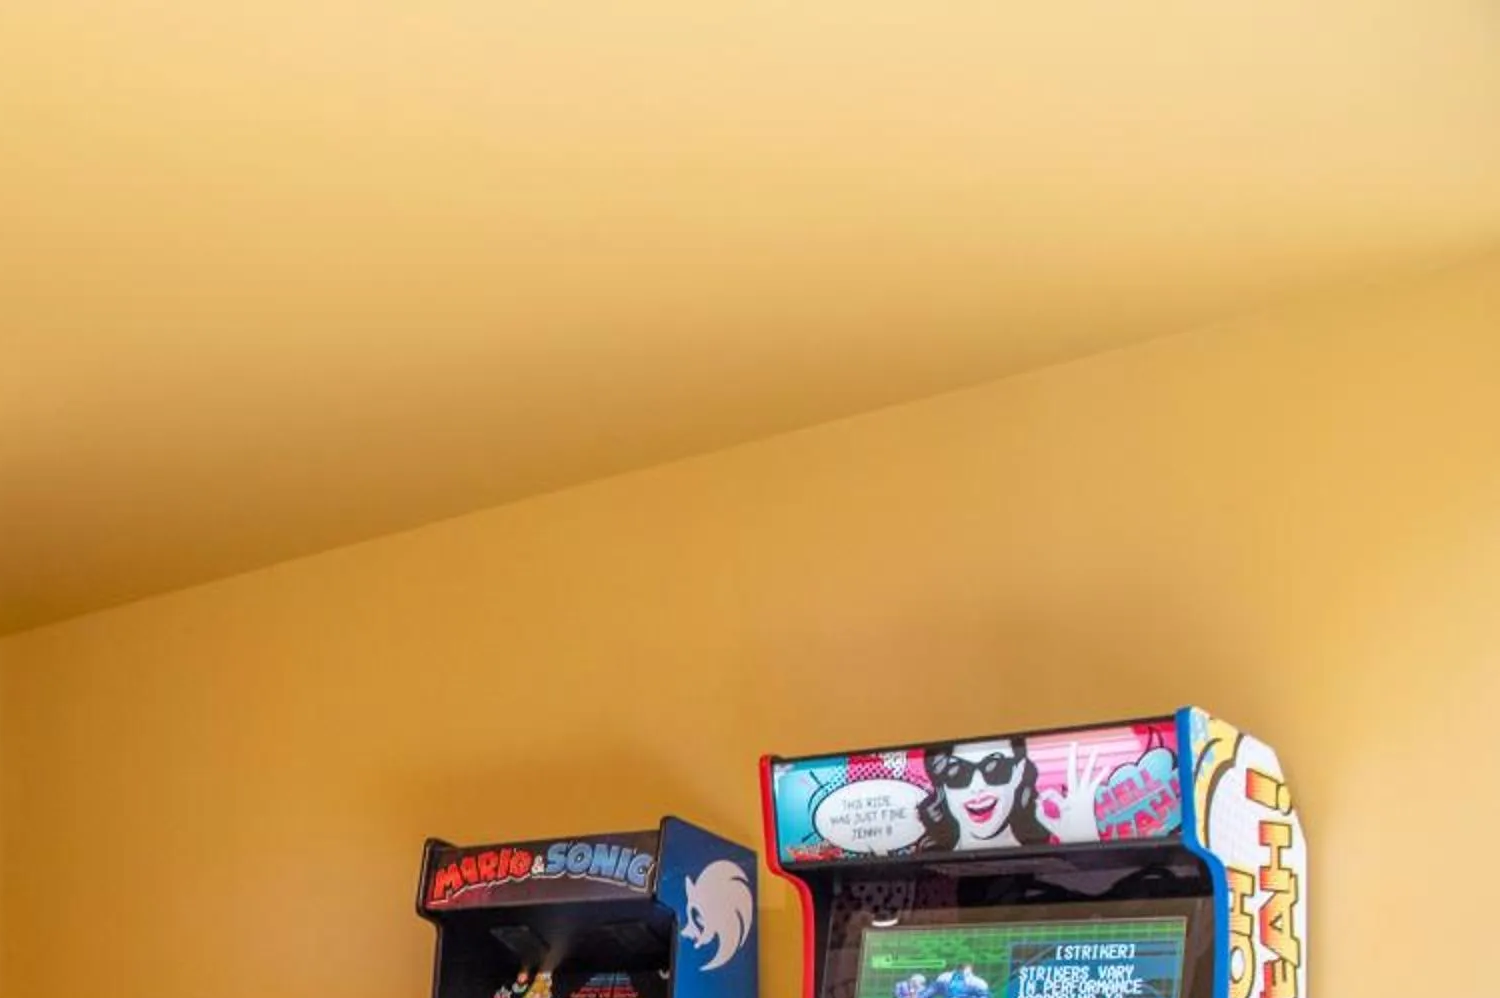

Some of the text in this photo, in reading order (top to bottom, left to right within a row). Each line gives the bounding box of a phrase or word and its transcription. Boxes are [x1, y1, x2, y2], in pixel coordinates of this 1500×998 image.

[433, 843, 653, 900] MARIO & SONIC
[1019, 964, 1136, 982] STRIKERS VARY
[1018, 978, 1144, 996] IN PERFORMANCE
